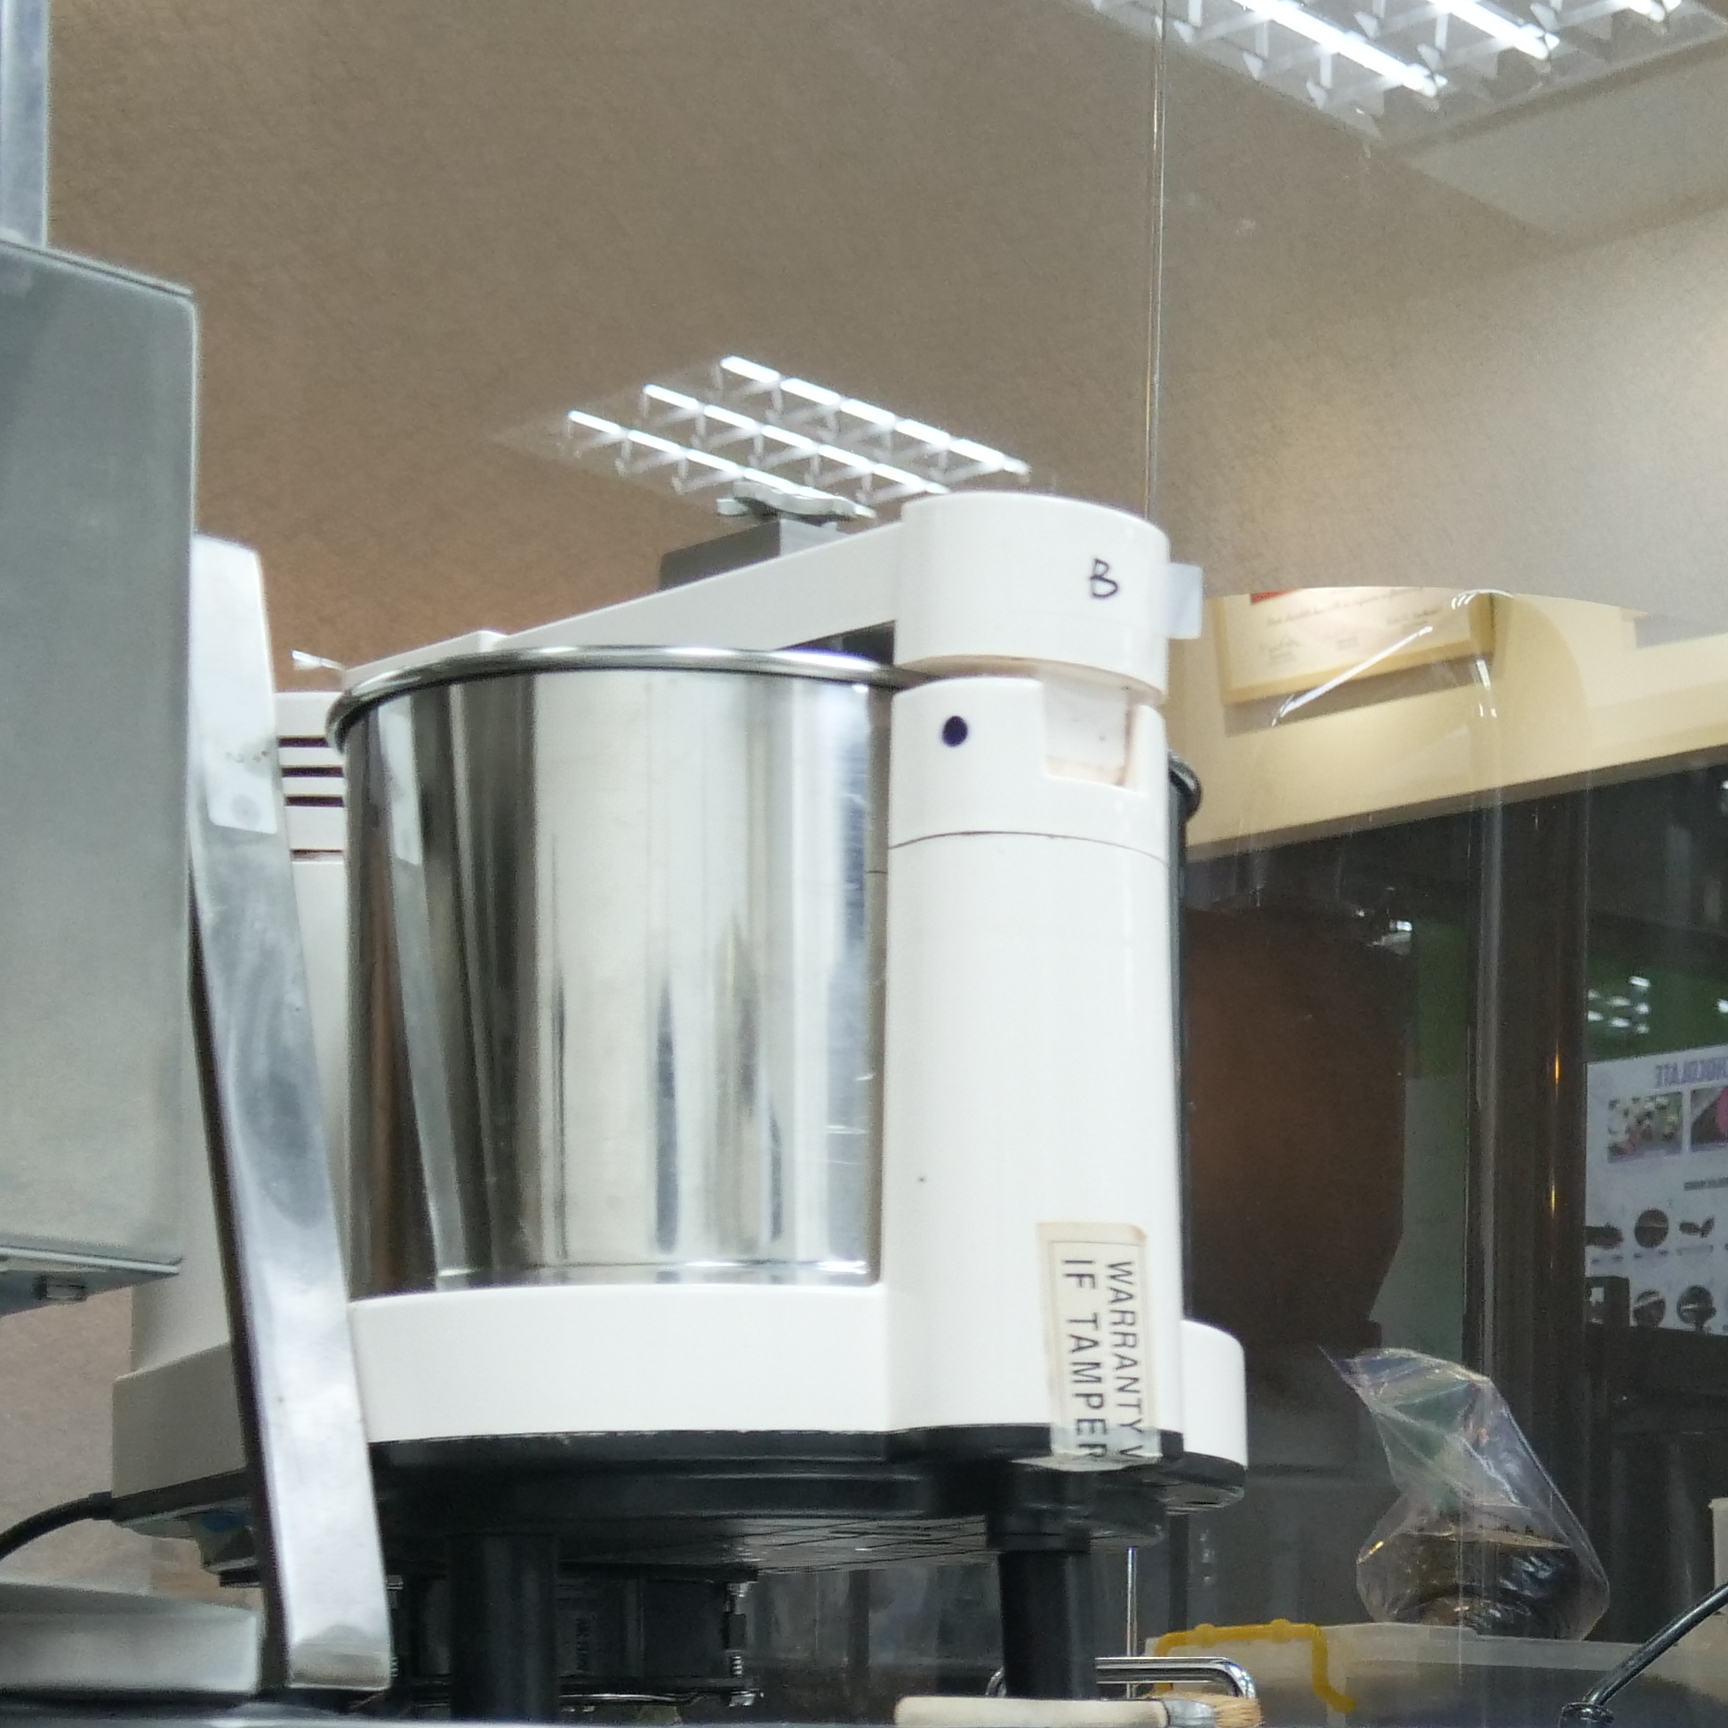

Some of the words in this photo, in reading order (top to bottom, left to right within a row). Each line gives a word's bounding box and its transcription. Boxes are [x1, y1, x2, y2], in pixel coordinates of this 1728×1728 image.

[1089, 558, 1118, 599] B
[1062, 1260, 1097, 1289] IF
[1068, 1312, 1108, 1458] TAMPER
[1105, 1261, 1144, 1433] WARRANTY
